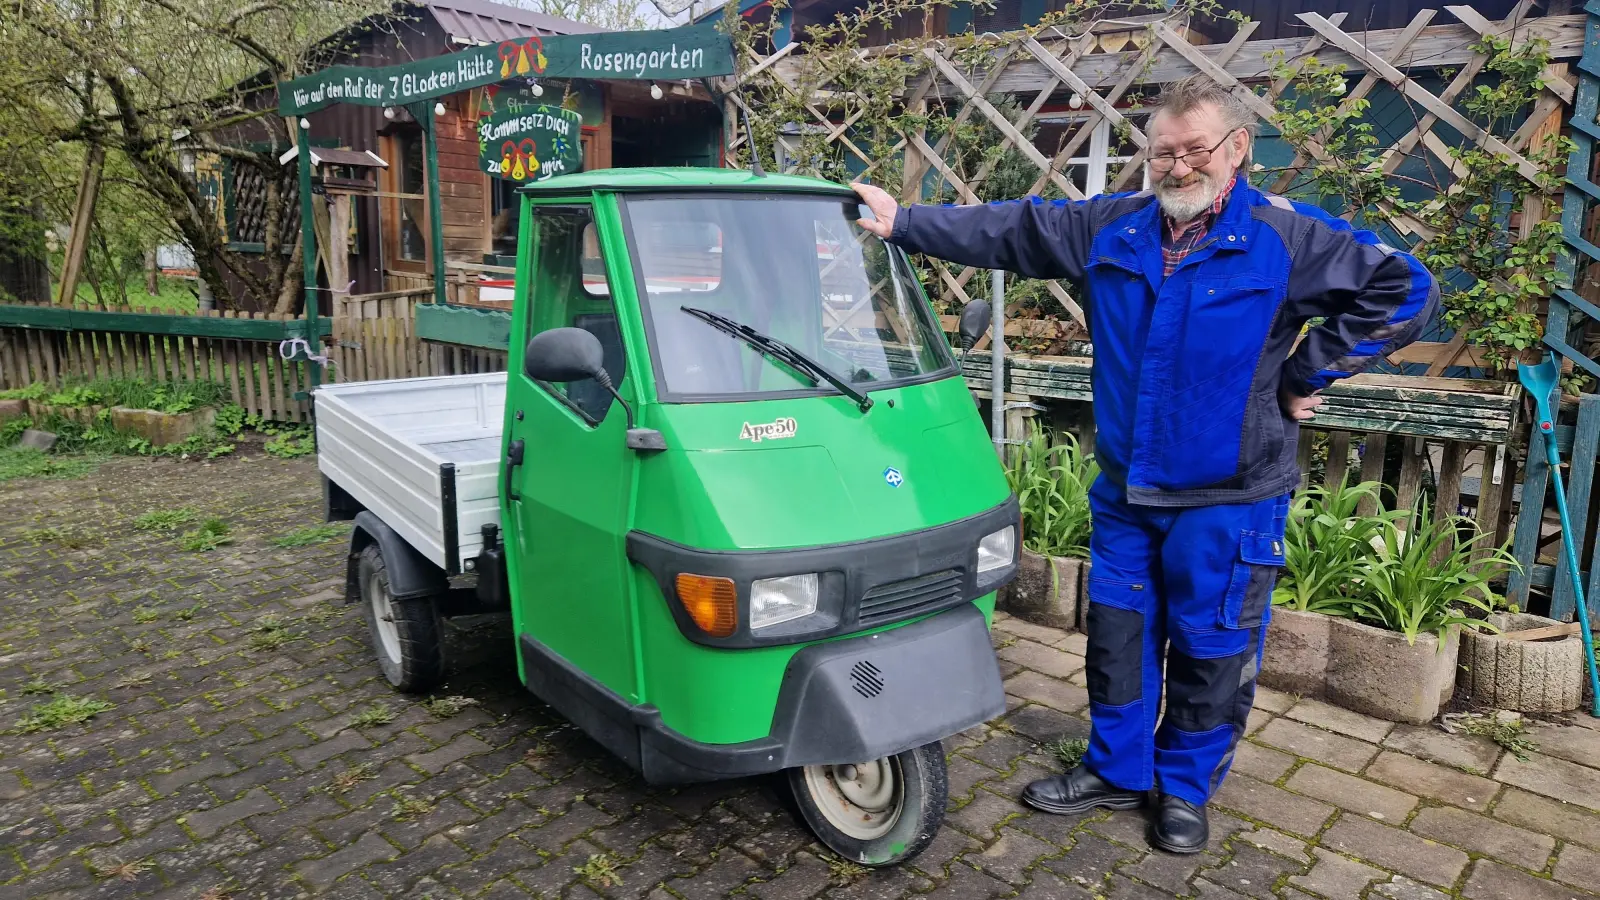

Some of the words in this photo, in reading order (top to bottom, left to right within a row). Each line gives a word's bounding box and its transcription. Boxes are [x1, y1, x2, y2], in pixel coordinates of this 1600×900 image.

[581, 43, 703, 78] Rosengarten
[293, 88, 309, 108] Hör
[310, 82, 325, 103] auf
[326, 81, 343, 98] den
[344, 76, 364, 98] Ruf
[364, 78, 385, 99] der
[388, 76, 399, 100] 3
[457, 53, 494, 83] Hütte
[481, 117, 520, 142] Komm
[538, 156, 565, 181] mir
